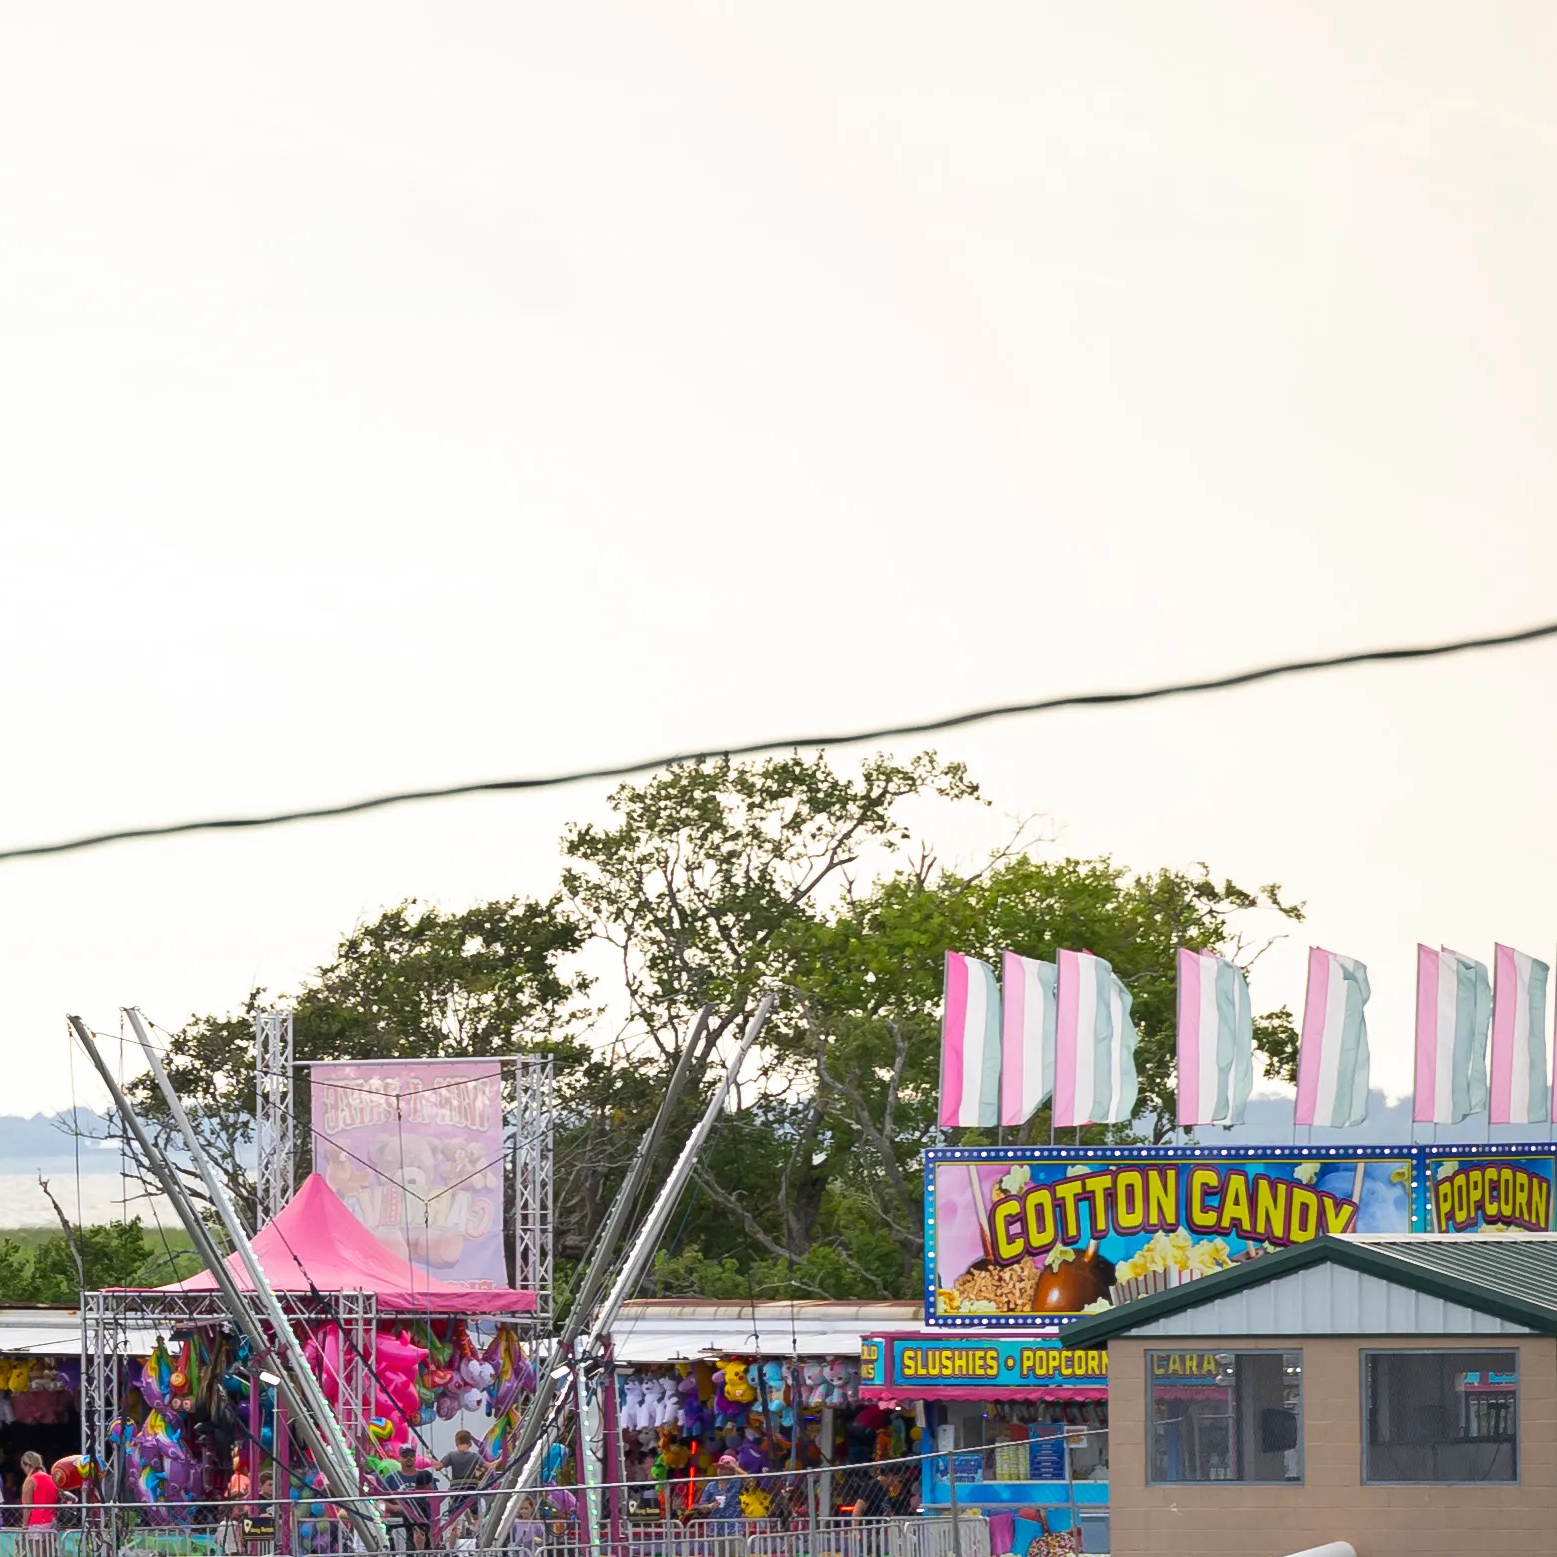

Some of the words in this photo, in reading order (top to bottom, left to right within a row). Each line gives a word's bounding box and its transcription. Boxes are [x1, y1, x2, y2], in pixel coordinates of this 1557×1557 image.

[994, 1166, 1177, 1260] COTTON
[1191, 1166, 1356, 1245] CANDY
[1438, 1167, 1547, 1231] POPCORN
[902, 1349, 999, 1376] SLUSHIES
